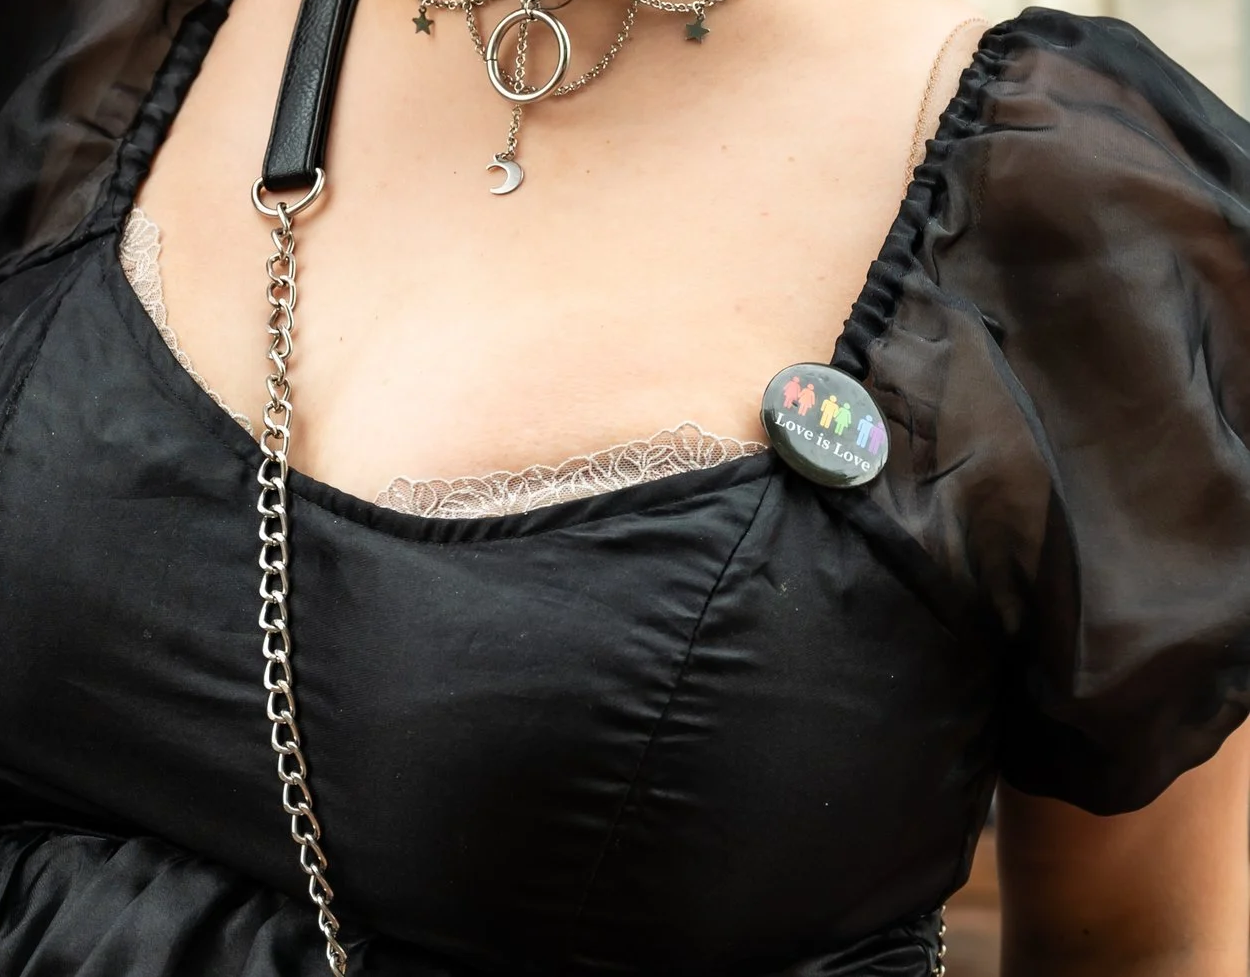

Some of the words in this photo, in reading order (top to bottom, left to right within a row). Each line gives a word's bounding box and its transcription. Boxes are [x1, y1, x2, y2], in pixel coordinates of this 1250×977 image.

[774, 412, 814, 441] Love
[816, 433, 830, 450] is
[833, 442, 870, 472] Love
